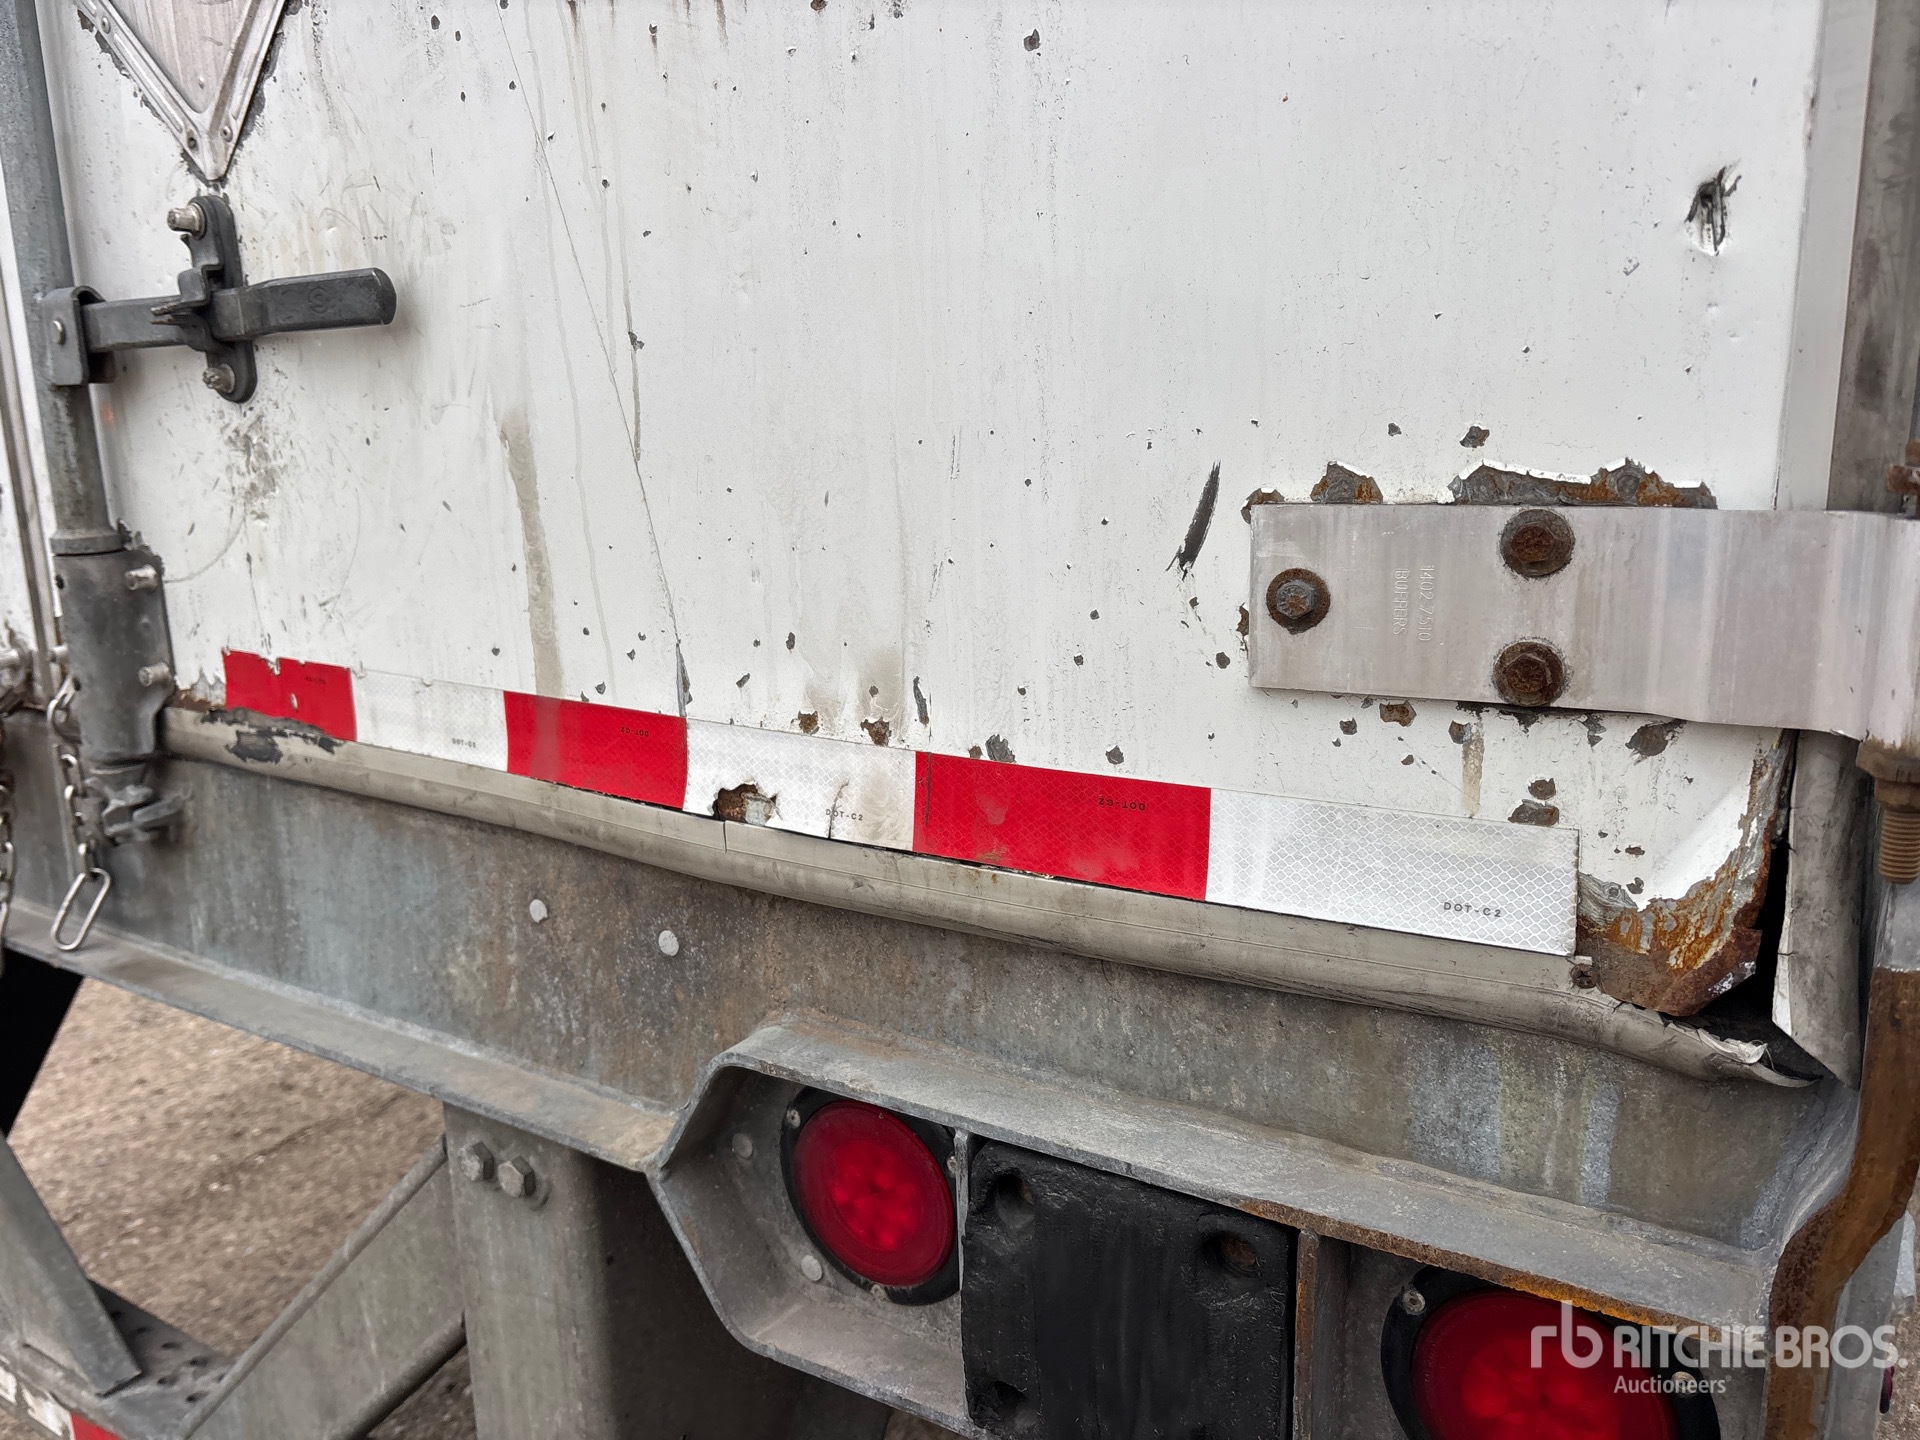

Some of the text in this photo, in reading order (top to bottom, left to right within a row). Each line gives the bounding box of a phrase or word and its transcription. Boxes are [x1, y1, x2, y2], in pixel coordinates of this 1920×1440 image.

[1419, 565, 1435, 600] 1402
[1099, 797, 1146, 811] DOT-C2
[825, 808, 863, 821] DOT-C2
[1443, 901, 1501, 917] DOT-C2
